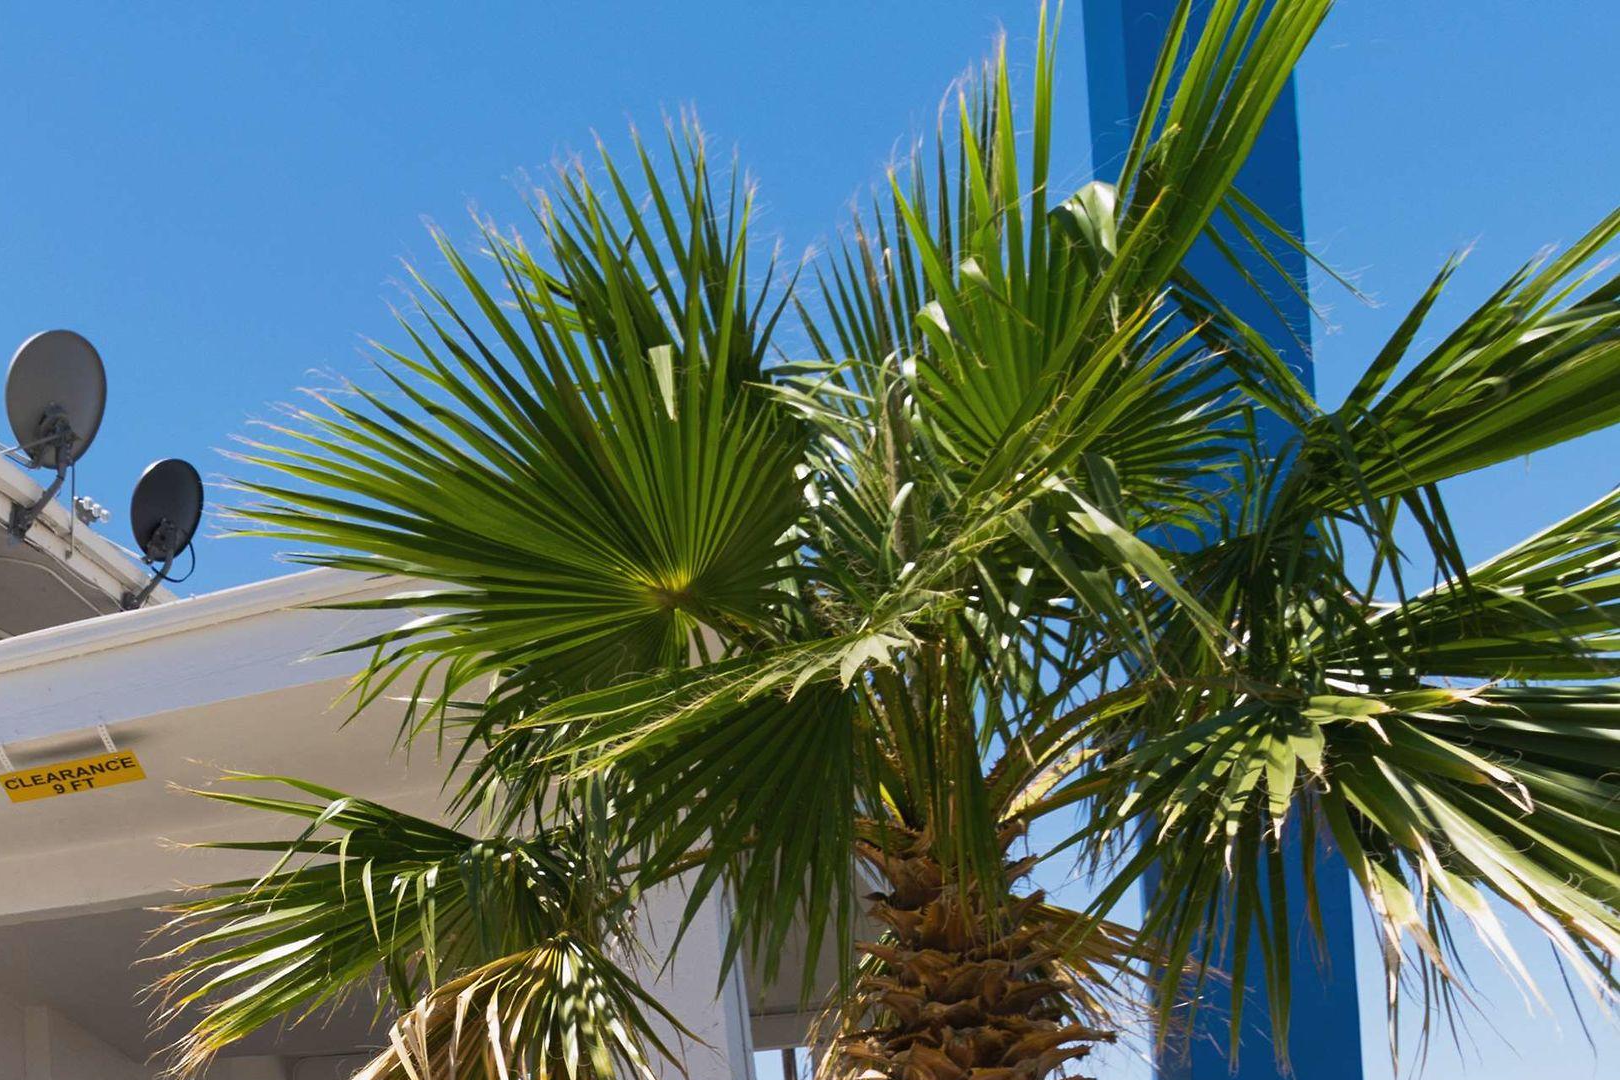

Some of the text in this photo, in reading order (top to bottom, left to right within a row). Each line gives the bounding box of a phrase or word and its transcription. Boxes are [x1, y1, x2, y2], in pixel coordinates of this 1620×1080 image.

[4, 756, 136, 791] CLEARANCE
[53, 777, 95, 795] 9 FT
